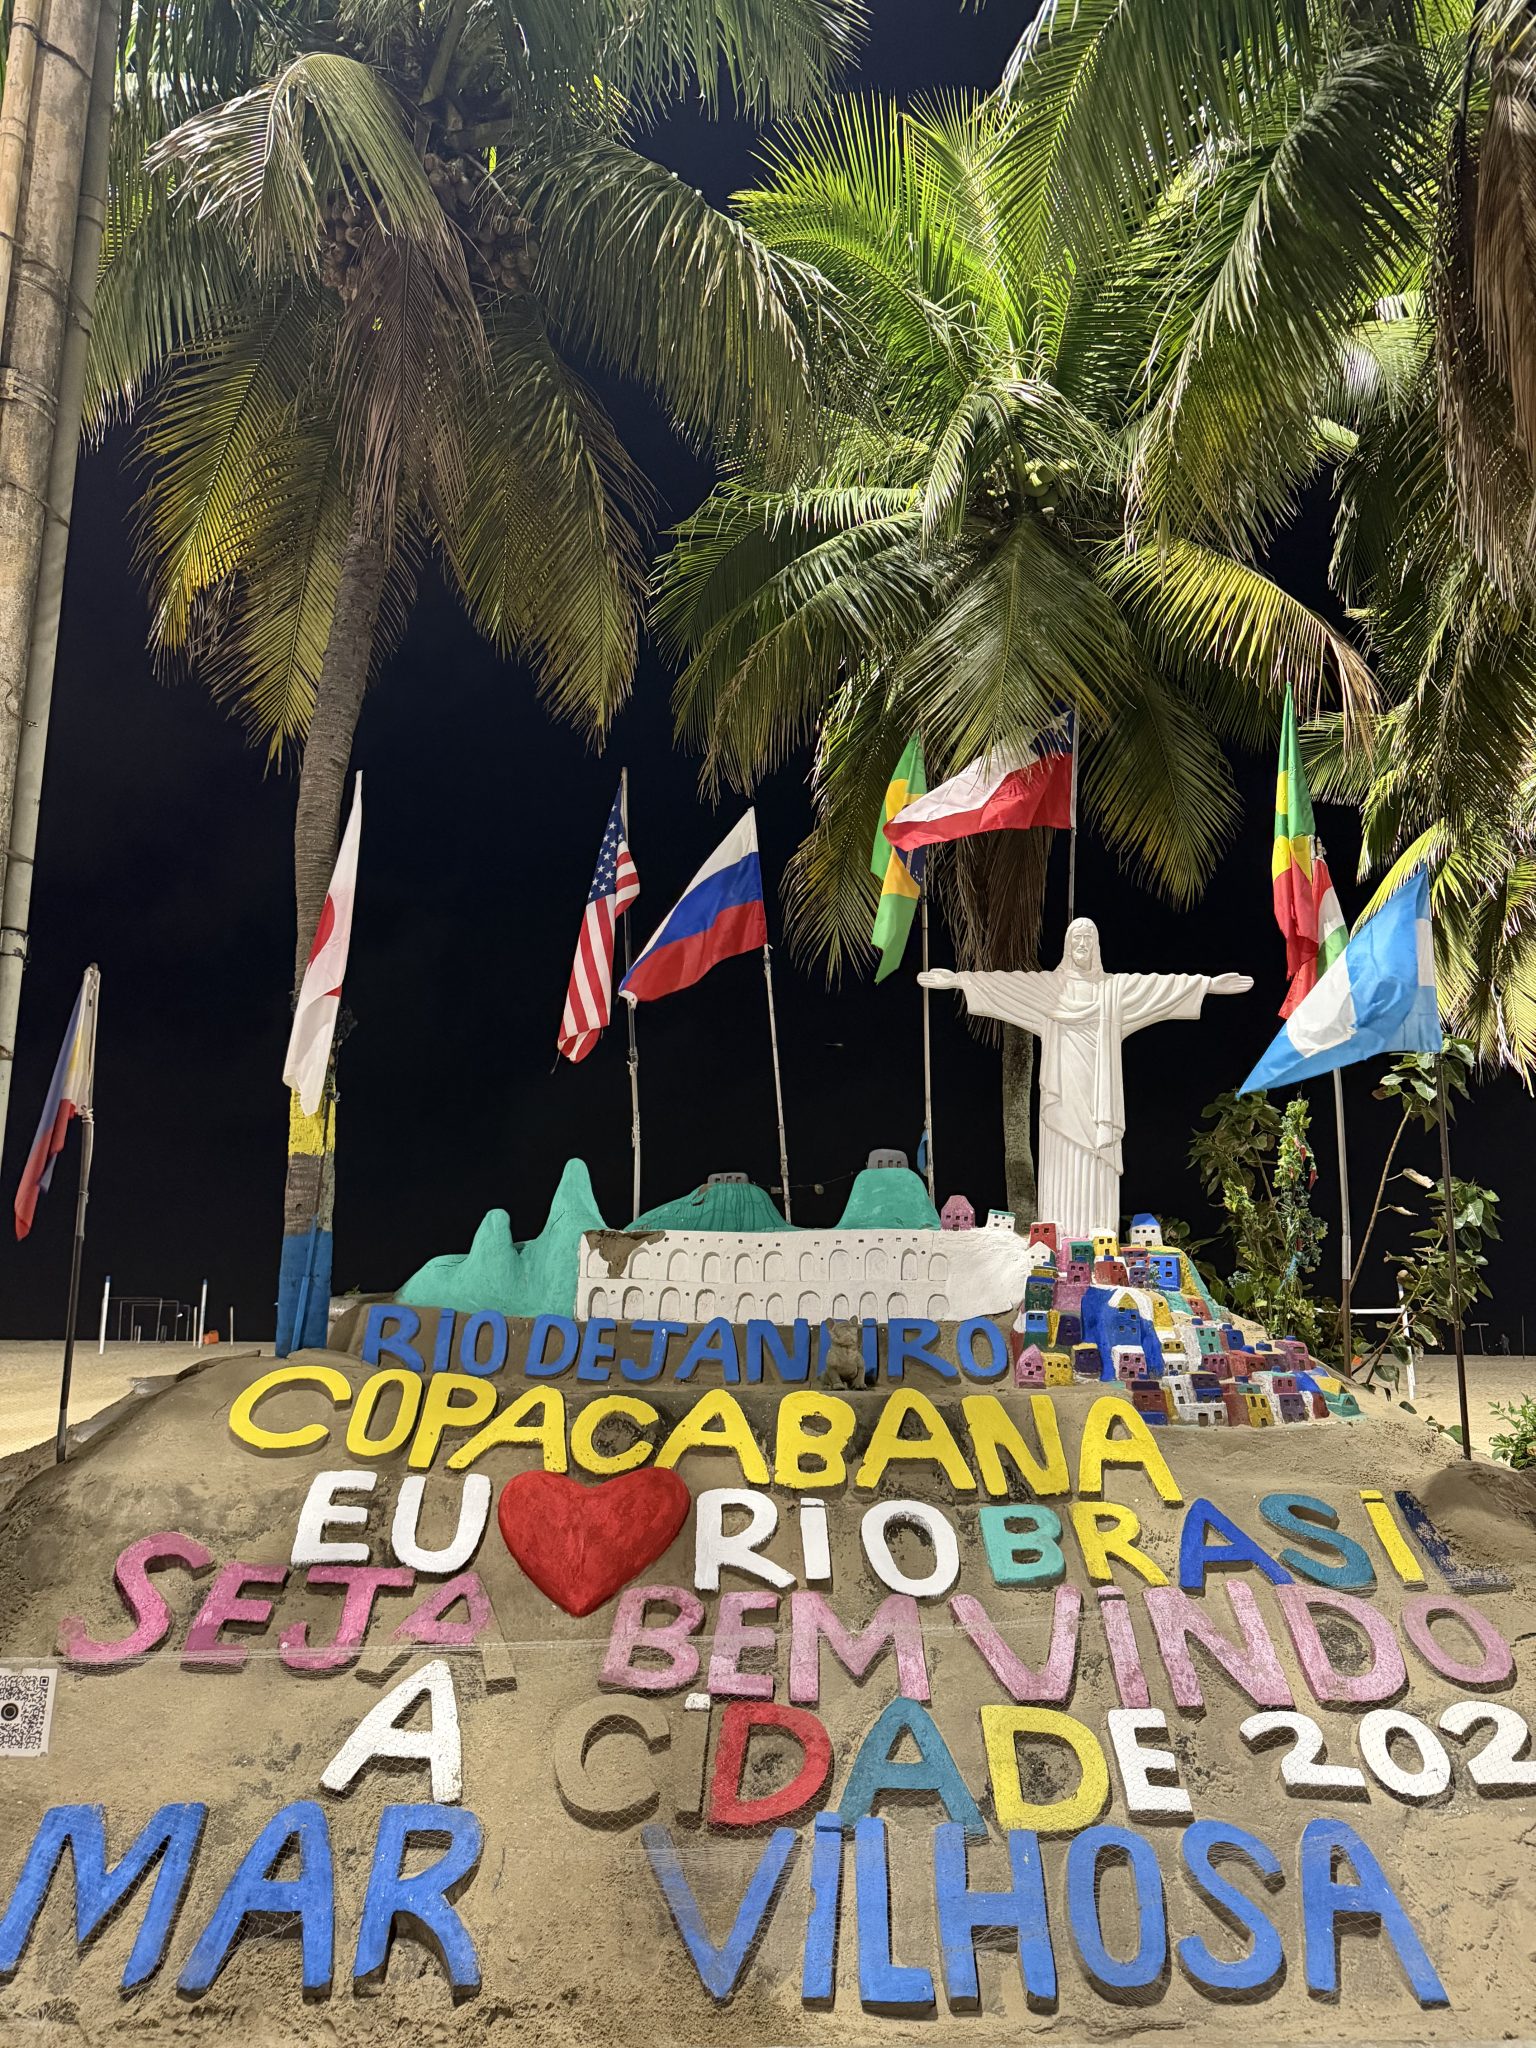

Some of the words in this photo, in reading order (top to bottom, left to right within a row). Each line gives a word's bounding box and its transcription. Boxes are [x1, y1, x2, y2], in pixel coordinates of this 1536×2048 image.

[229, 1365, 1184, 1504] COPACABANA
[291, 1470, 491, 1574] EU
[58, 1531, 517, 1692] SEJA
[320, 1659, 463, 1803] A
